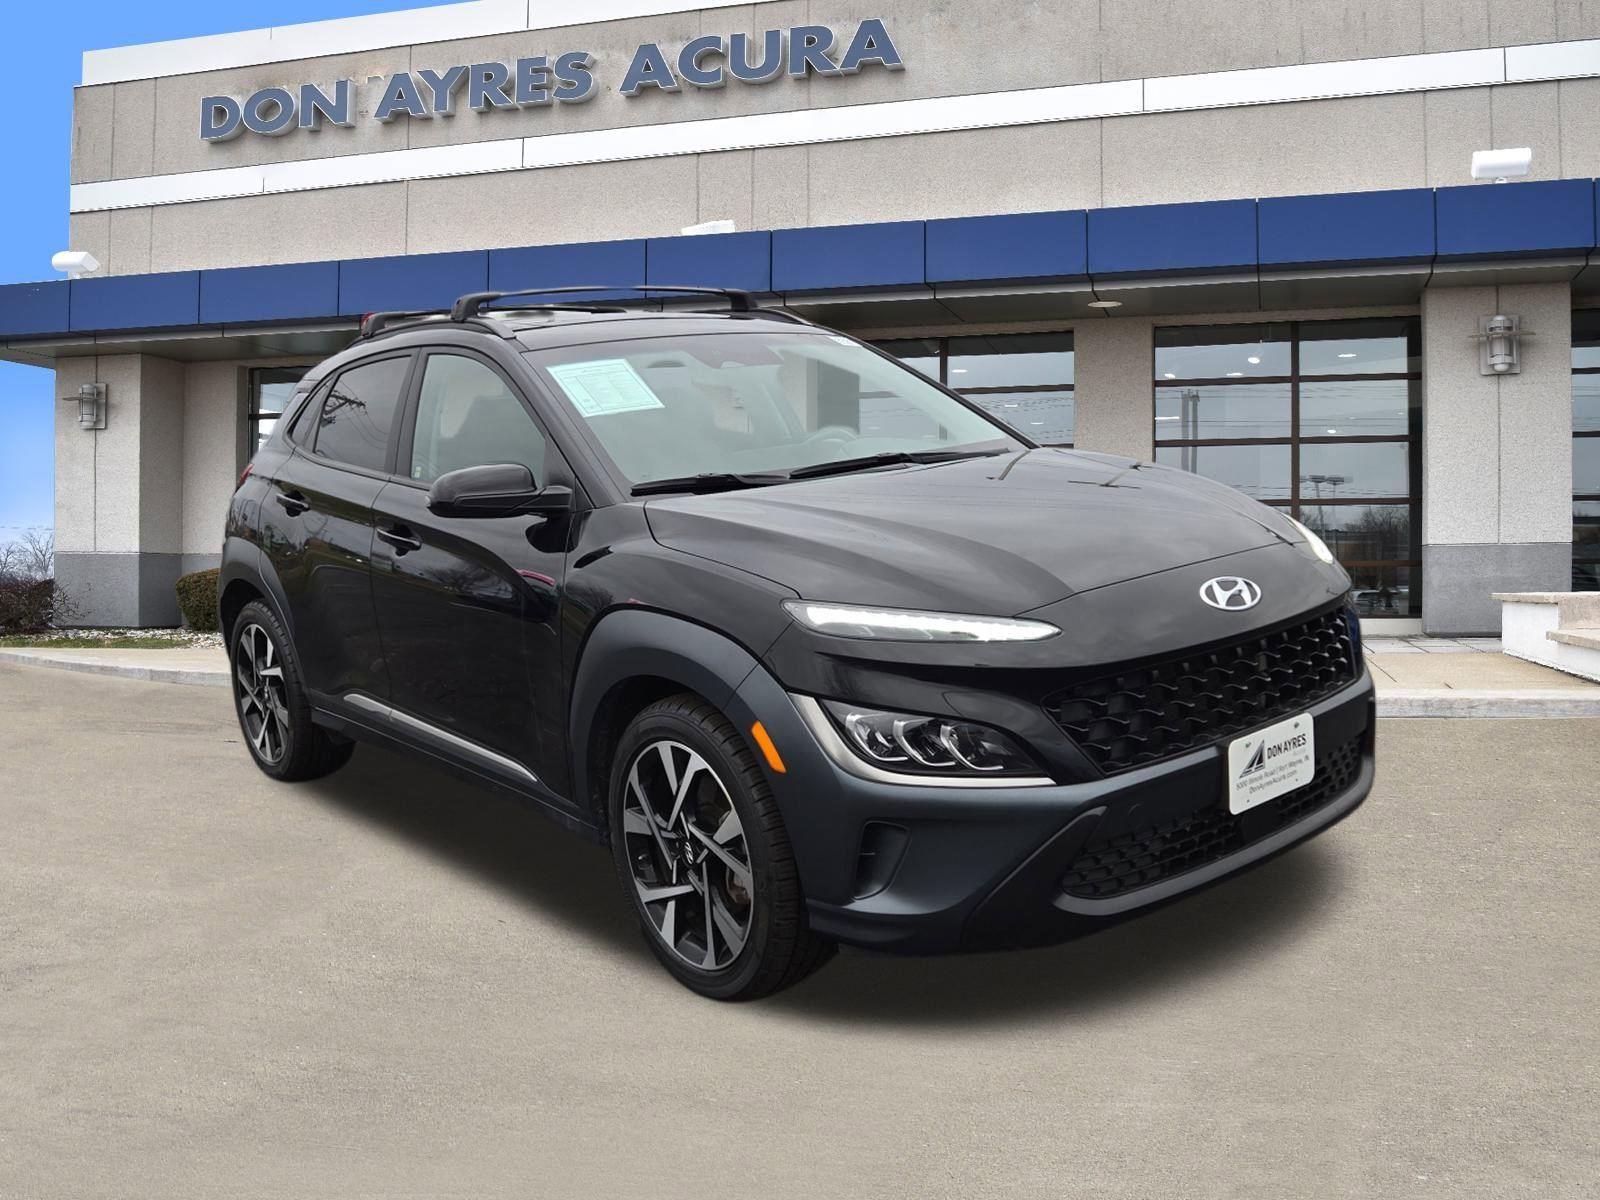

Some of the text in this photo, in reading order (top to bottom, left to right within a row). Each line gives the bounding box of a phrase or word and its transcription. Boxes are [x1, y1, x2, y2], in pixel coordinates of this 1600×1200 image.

[199, 18, 905, 142] DON AYRES ACURA
[1267, 743, 1283, 760] DON
[1283, 733, 1307, 754] AYRES
